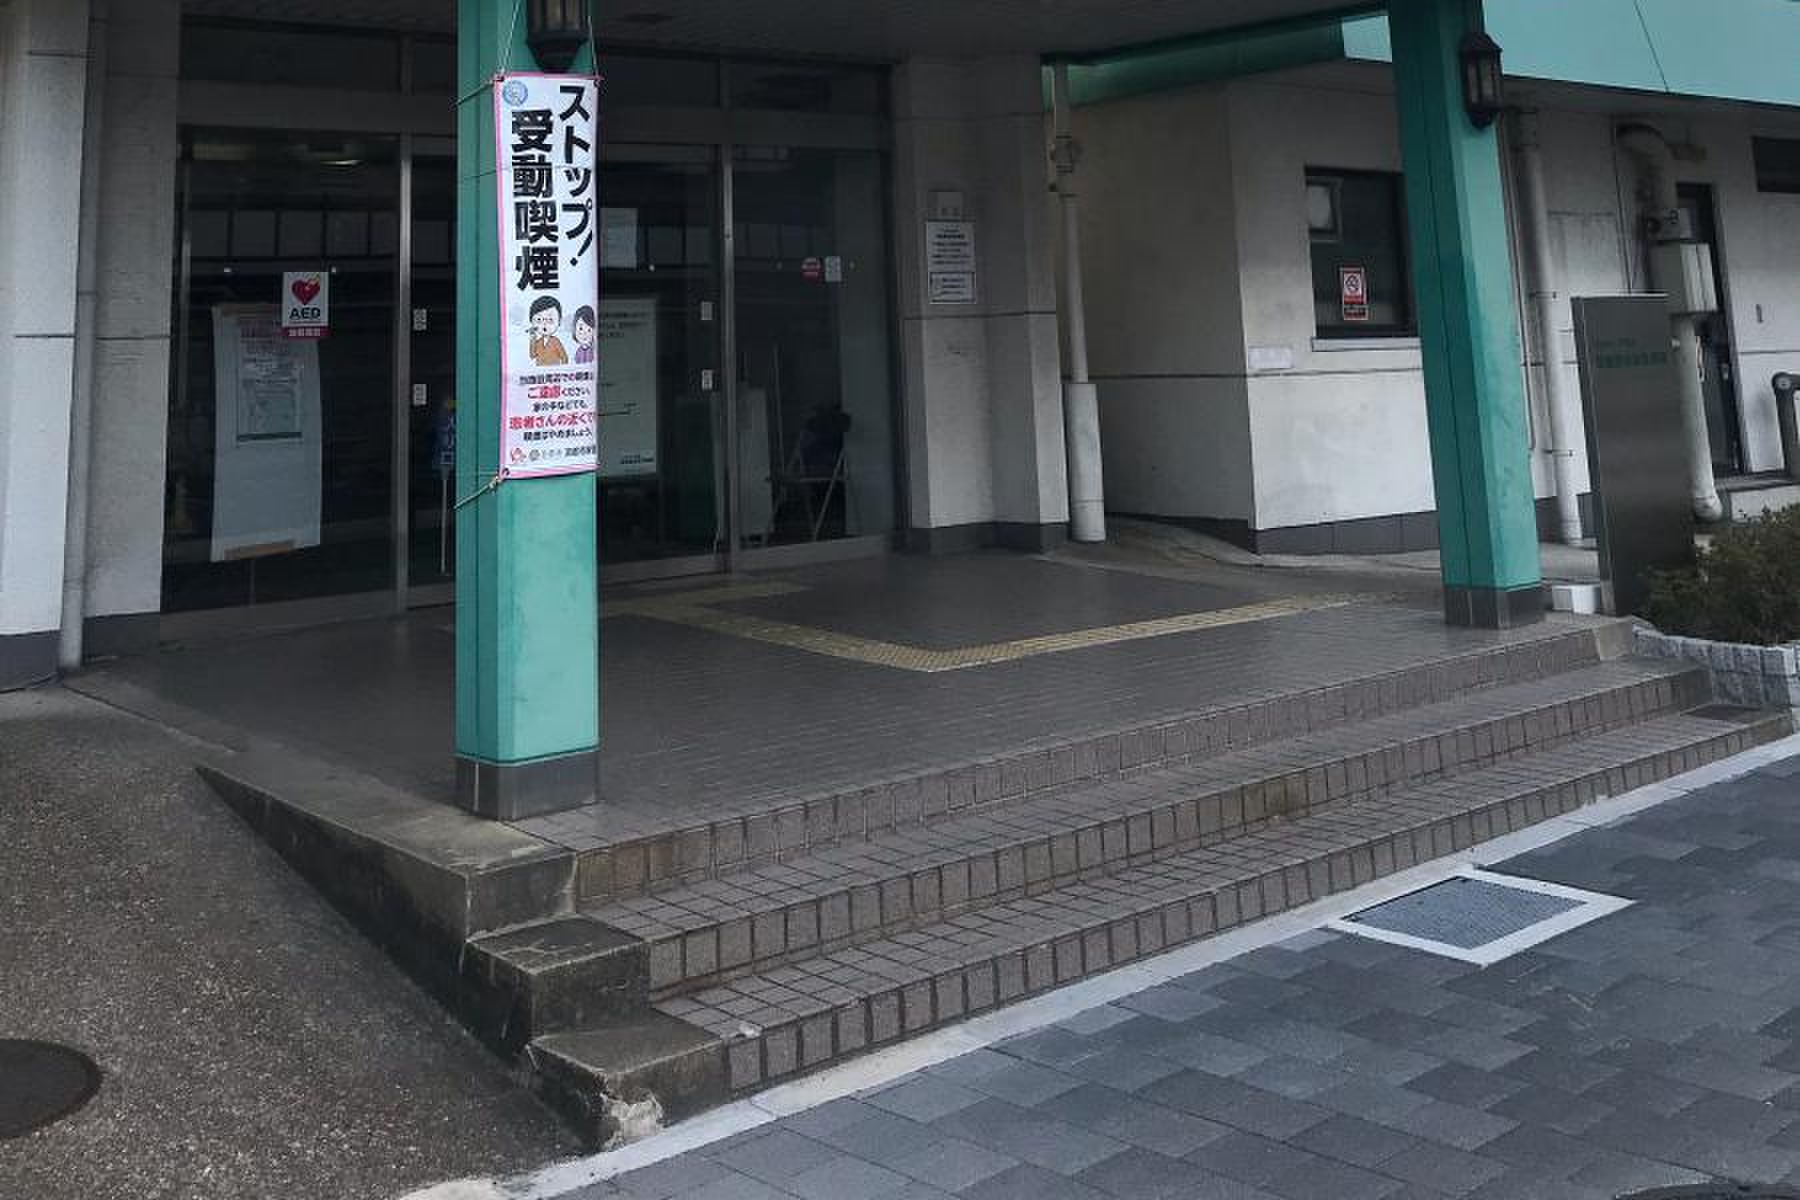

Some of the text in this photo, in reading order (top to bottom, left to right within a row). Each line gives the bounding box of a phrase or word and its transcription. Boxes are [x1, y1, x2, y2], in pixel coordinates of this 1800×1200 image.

[511, 108, 560, 291] 受動喫煙
[289, 307, 321, 320] AED
